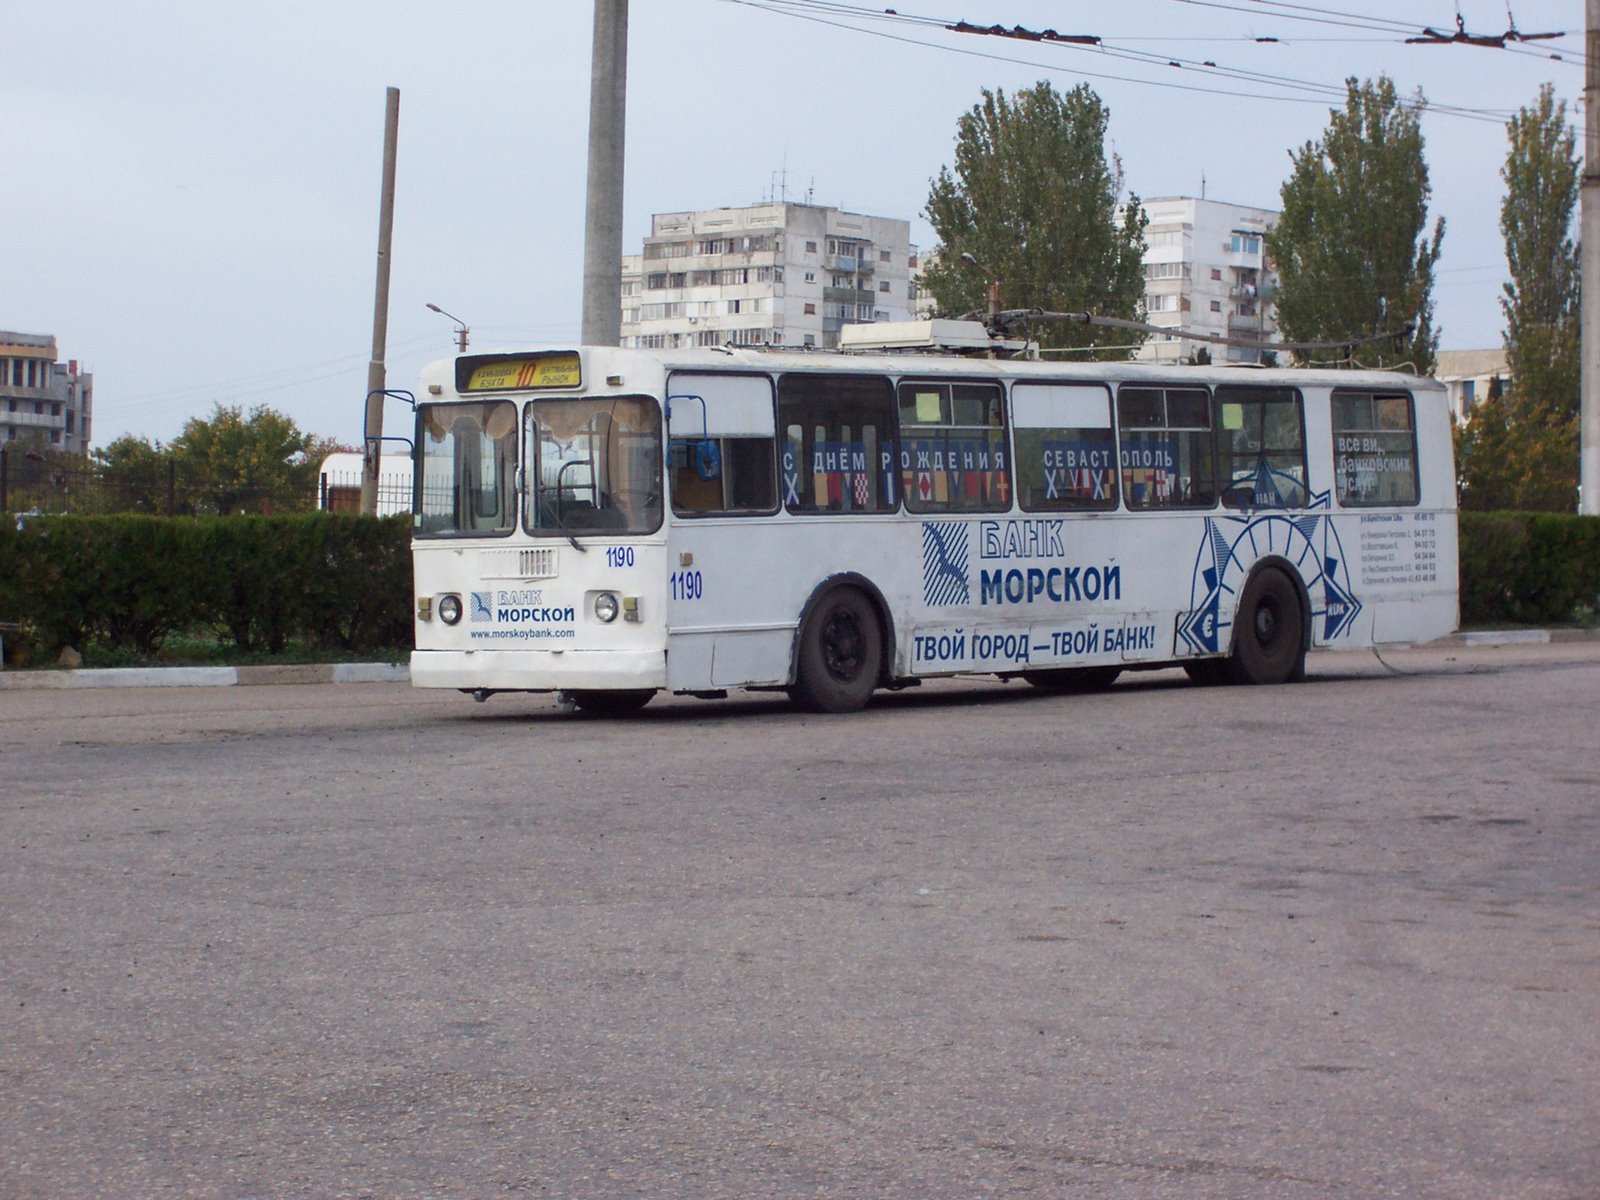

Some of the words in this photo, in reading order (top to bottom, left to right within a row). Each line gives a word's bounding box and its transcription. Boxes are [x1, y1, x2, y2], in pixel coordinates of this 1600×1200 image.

[480, 377, 505, 388] БУХТА
[515, 363, 537, 388] 10
[542, 374, 569, 384] РЫНОК
[783, 452, 793, 470] С
[813, 449, 865, 473] ДНЁМ
[980, 520, 1065, 559] БАНК
[606, 547, 635, 568] 1190
[670, 571, 703, 600] 1190
[980, 557, 1121, 605] МОРСКОЙ
[497, 590, 543, 605] БАНК
[497, 605, 575, 622] МОРСКОЙ
[470, 629, 576, 641] www.morskoybank.com
[914, 629, 966, 662] ТВОЙ
[971, 633, 1029, 663] ГОРОД
[1103, 626, 1156, 655] БАНК!
